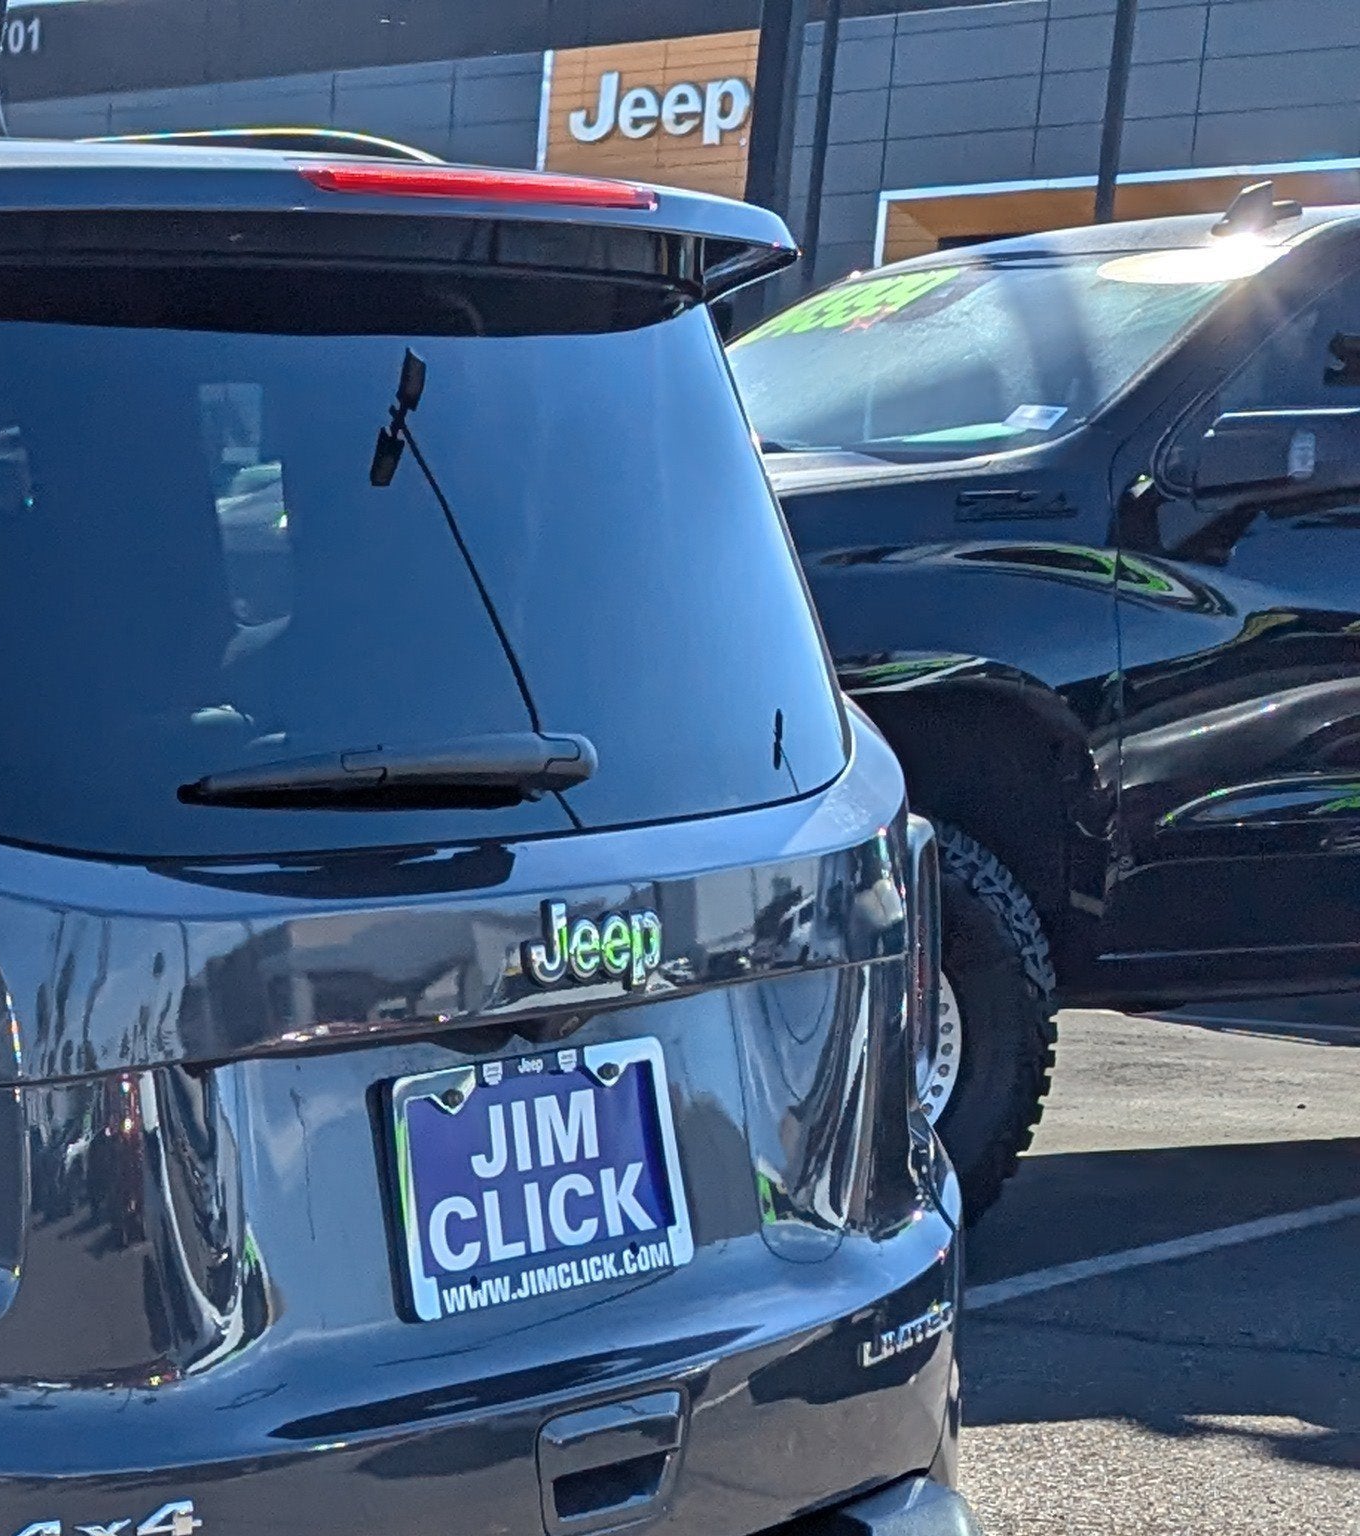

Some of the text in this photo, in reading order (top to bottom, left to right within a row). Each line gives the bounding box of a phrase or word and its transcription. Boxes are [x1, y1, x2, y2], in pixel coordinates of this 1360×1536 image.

[1, 18, 40, 54] 01
[569, 70, 751, 146] Jeep
[526, 900, 661, 986] Jeep
[470, 1088, 600, 1179] JIM
[428, 1161, 658, 1272] CLICK
[442, 1241, 671, 1315] WWW.JIMCLICK.COM
